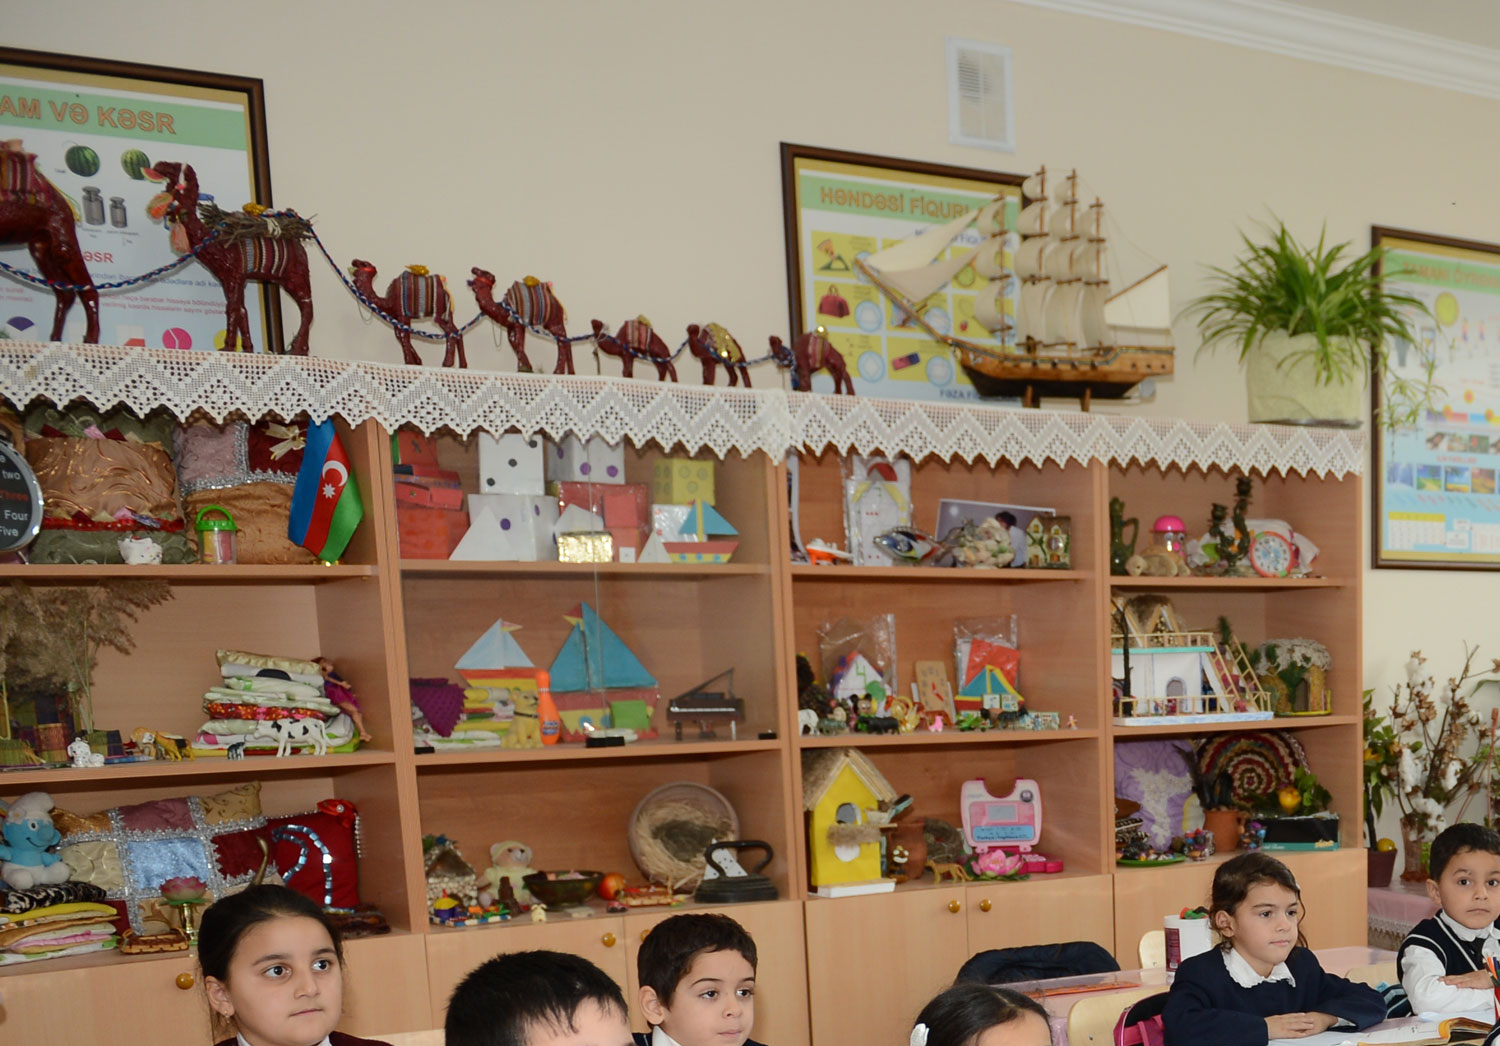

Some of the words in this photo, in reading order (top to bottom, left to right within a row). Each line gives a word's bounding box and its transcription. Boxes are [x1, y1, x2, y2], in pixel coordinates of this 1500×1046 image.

[0, 96, 41, 119] AM
[48, 100, 88, 124] VƏ
[97, 106, 176, 134] KƏSR
[820, 186, 905, 213] HƏNDƏSİ
[82, 251, 114, 264] ƏSR
[3, 470, 20, 480] two
[4, 510, 28, 520] Four
